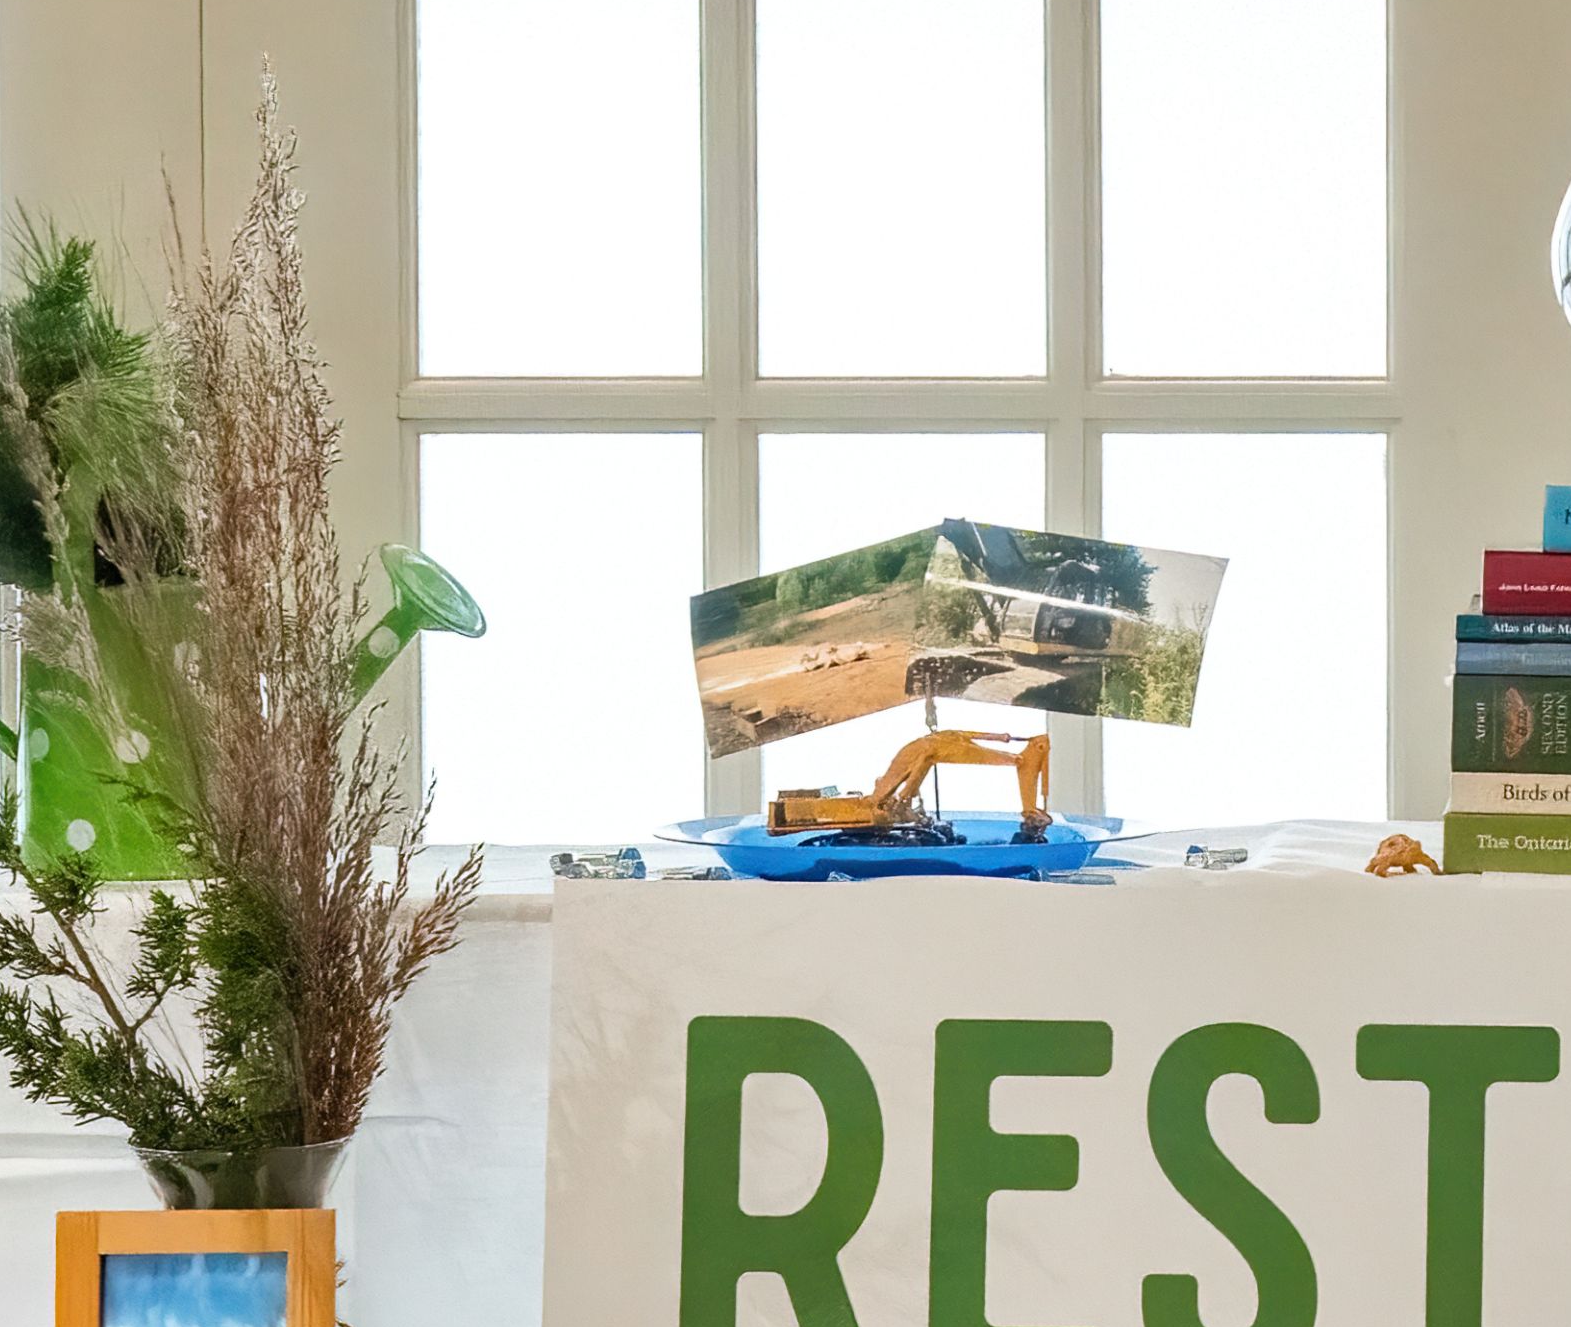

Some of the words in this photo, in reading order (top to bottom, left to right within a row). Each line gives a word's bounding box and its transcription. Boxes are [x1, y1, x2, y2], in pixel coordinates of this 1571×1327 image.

[1491, 623, 1520, 634] Atlas
[1523, 622, 1534, 634] of
[1536, 622, 1555, 635] the
[1555, 693, 1568, 754] EDITION
[1502, 784, 1547, 801] Birds
[1552, 784, 1571, 802] of
[1477, 834, 1509, 850] The
